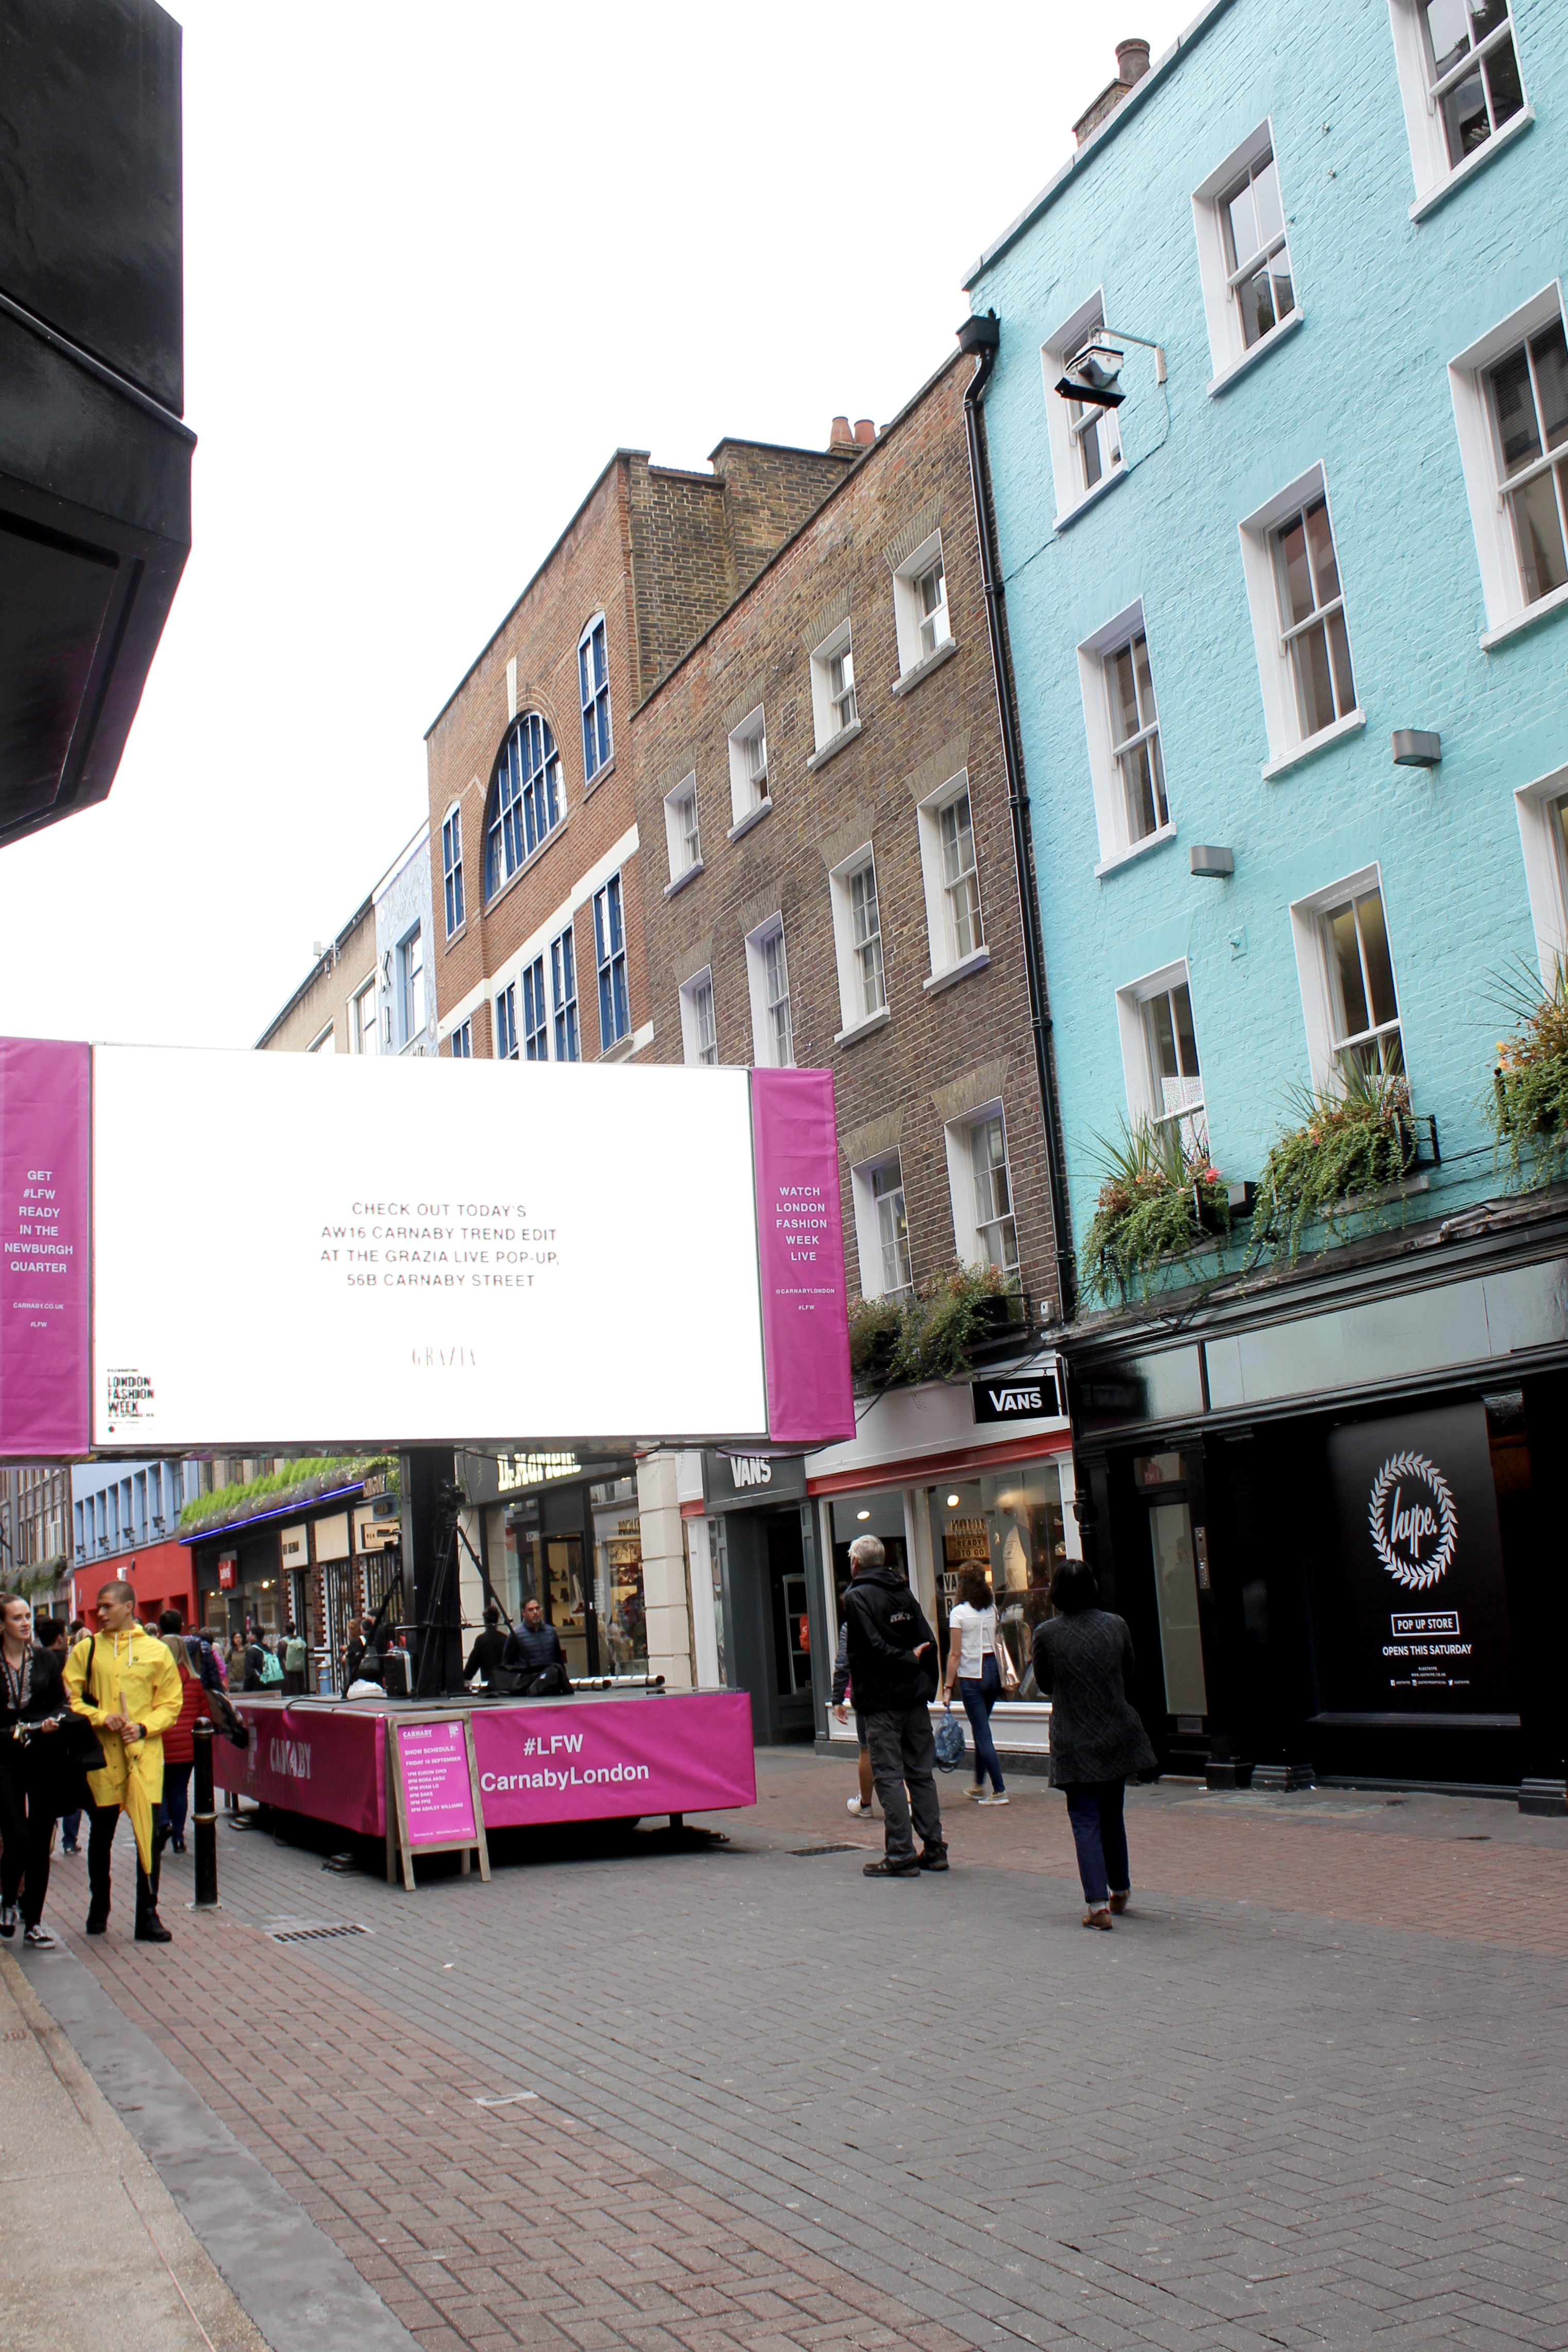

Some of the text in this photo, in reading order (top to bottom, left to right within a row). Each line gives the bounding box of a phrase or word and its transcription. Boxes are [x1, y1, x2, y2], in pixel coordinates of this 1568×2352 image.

[27, 1171, 52, 1181] GET
[23, 1188, 55, 1199] #LFW
[779, 1187, 820, 1196] WATCH
[19, 1206, 60, 1218] READY
[353, 1202, 526, 1217] CHECK OUT TODAY'S
[776, 1203, 825, 1212] LONDON
[776, 1219, 827, 1228] FASHION
[20, 1225, 58, 1236] IN THE
[322, 1226, 556, 1240] AW16 CARNABY TREND EDIT
[786, 1236, 819, 1245] WEEK
[5, 1243, 73, 1254] NEWBURGH
[321, 1250, 558, 1265] AT THE GRAZIA LIVE POP-UP,
[791, 1252, 816, 1260] LIVE
[11, 1261, 66, 1273] QUARTER
[348, 1273, 534, 1287] 56B CARNABY STREET
[108, 1376, 151, 1387] LONDON
[108, 1389, 154, 1399] FASHION
[988, 1387, 1043, 1411] VANS
[729, 1456, 771, 1488] VANS
[957, 1538, 982, 1547] READY
[1397, 1618, 1453, 1630] POP UP STORE
[1382, 1644, 1472, 1656] OPENS THIS SATURDAY
[403, 1729, 432, 1737] CARNABY
[423, 1745, 456, 1754] SCHEDULE:
[523, 1733, 583, 1756] #LFW
[481, 1763, 649, 1792] CarnabyLondon
